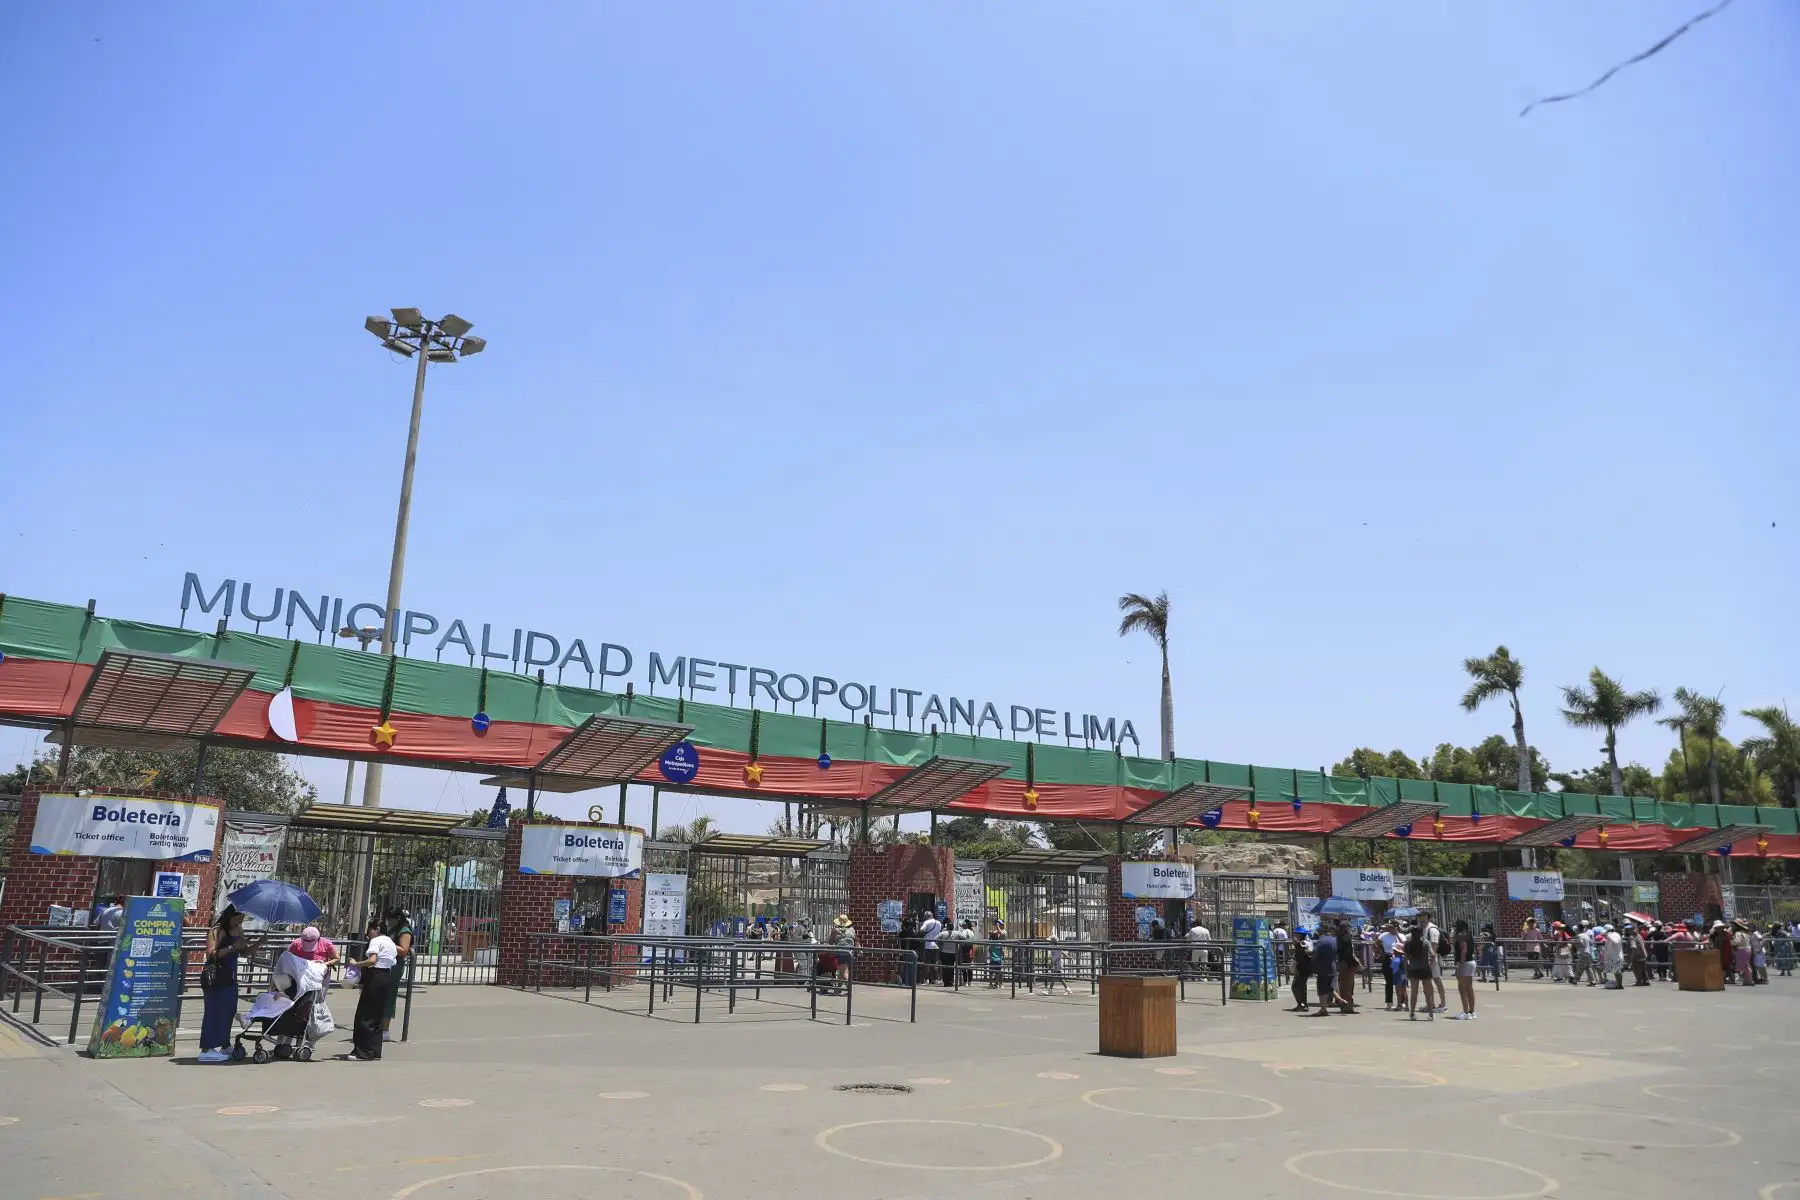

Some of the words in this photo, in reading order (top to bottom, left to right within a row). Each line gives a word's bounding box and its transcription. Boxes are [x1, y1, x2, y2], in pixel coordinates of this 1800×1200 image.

[180, 571, 633, 677] MUNICIPALIDAD
[649, 651, 1004, 729] METROPOLITANA
[1011, 704, 1058, 736] DE
[1065, 711, 1140, 746] LIMA
[92, 805, 181, 827] Boletería
[588, 804, 604, 823] 6
[75, 832, 99, 841] Ticket
[101, 833, 125, 842] office
[564, 834, 624, 850] Boletería
[227, 850, 260, 865] 100%
[553, 855, 572, 863] Ticket
[1153, 868, 1190, 878] Boletería
[133, 919, 176, 928] COMPRA
[135, 927, 173, 936] ONLINE
